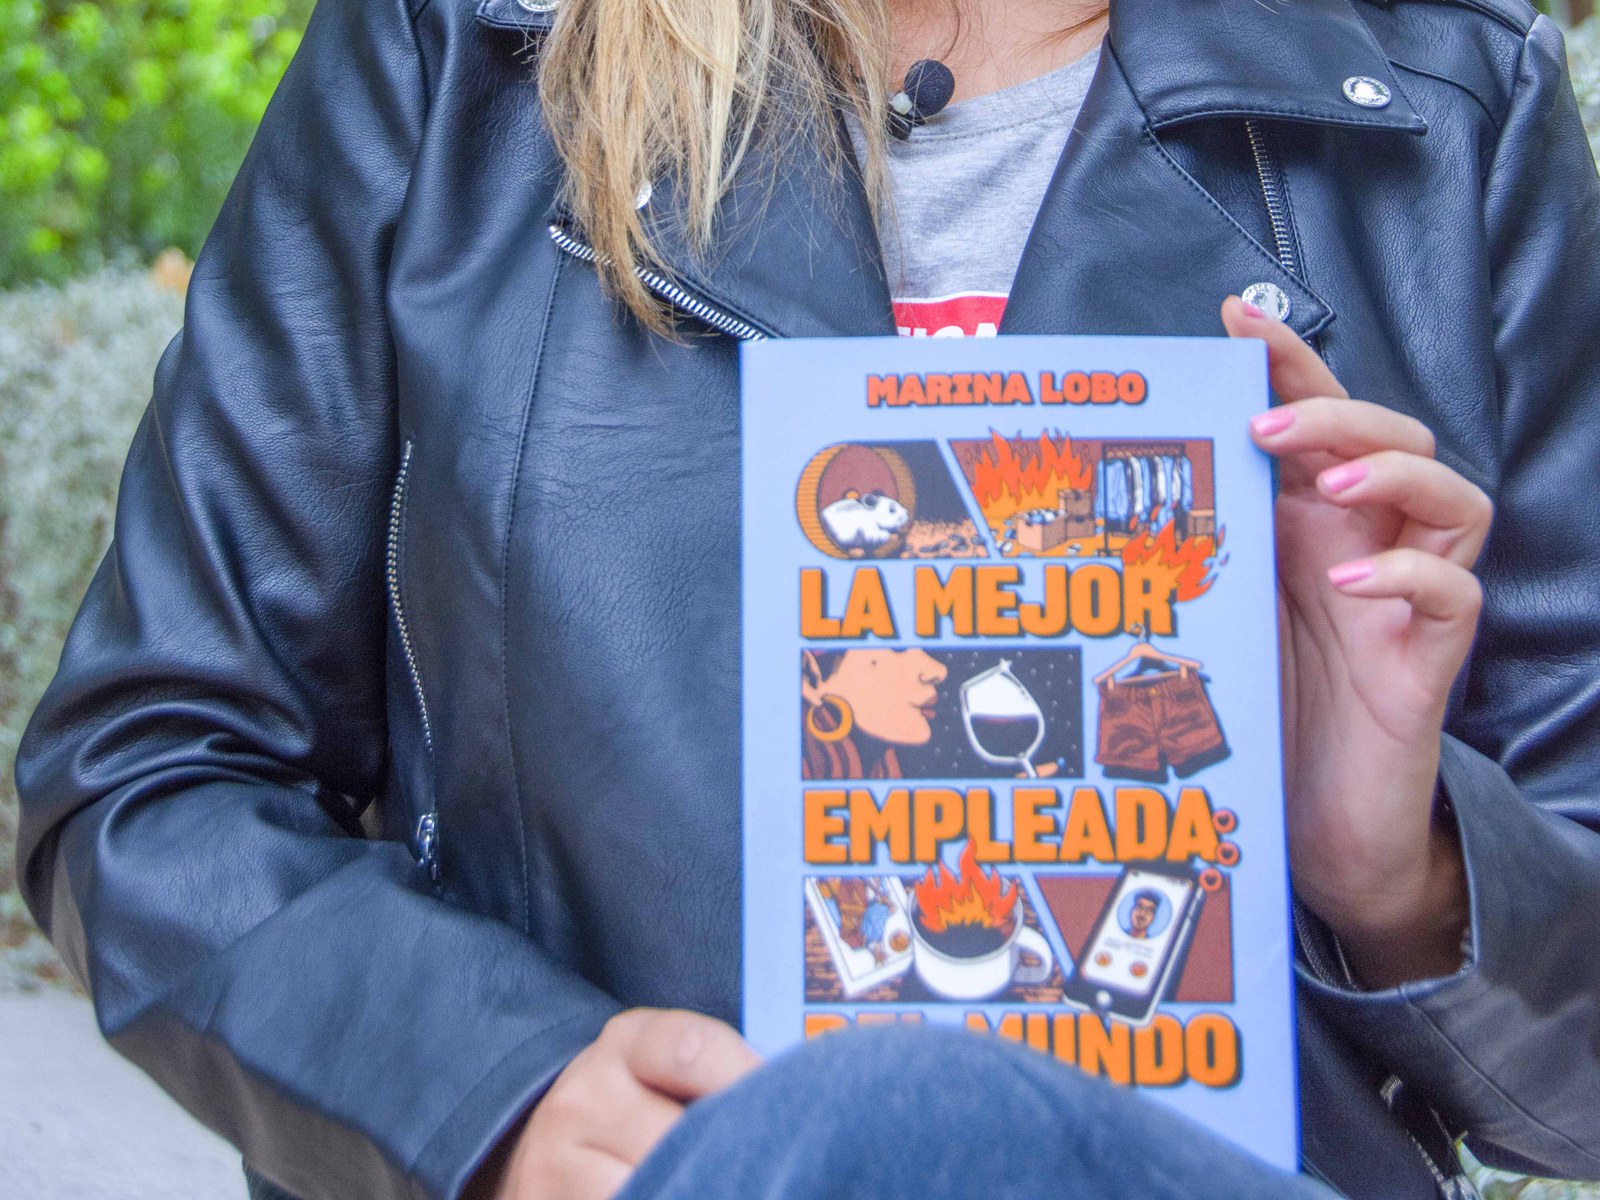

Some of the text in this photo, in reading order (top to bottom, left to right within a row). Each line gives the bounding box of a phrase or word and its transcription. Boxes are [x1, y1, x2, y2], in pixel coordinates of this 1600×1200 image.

[866, 371, 1148, 408] MARINA LOBO
[800, 565, 1177, 639] LA MEJOR
[803, 787, 1220, 864] EMPLEADA
